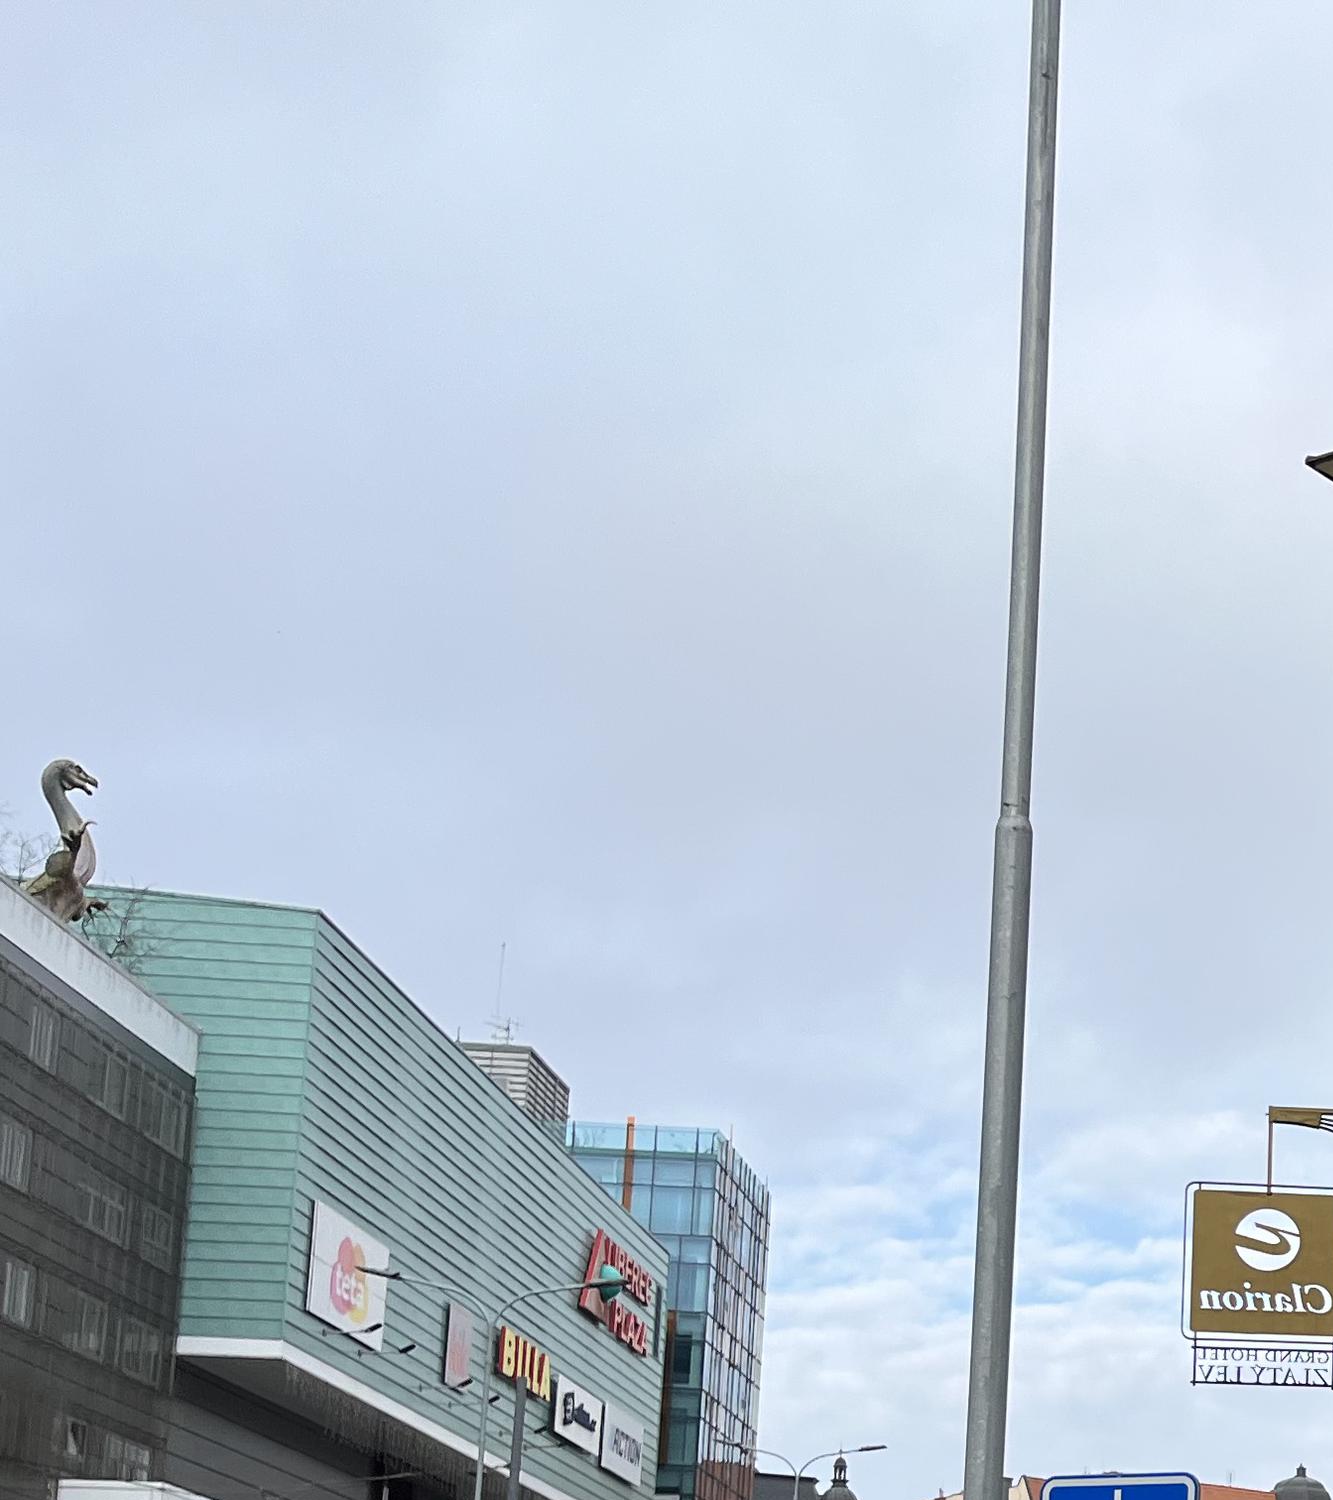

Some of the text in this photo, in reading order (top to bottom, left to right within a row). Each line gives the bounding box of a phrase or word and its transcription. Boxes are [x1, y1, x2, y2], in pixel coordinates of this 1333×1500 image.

[608, 1299, 647, 1358] PLAZA
[498, 1326, 550, 1401] BILLA
[612, 1427, 642, 1467] ACTION
